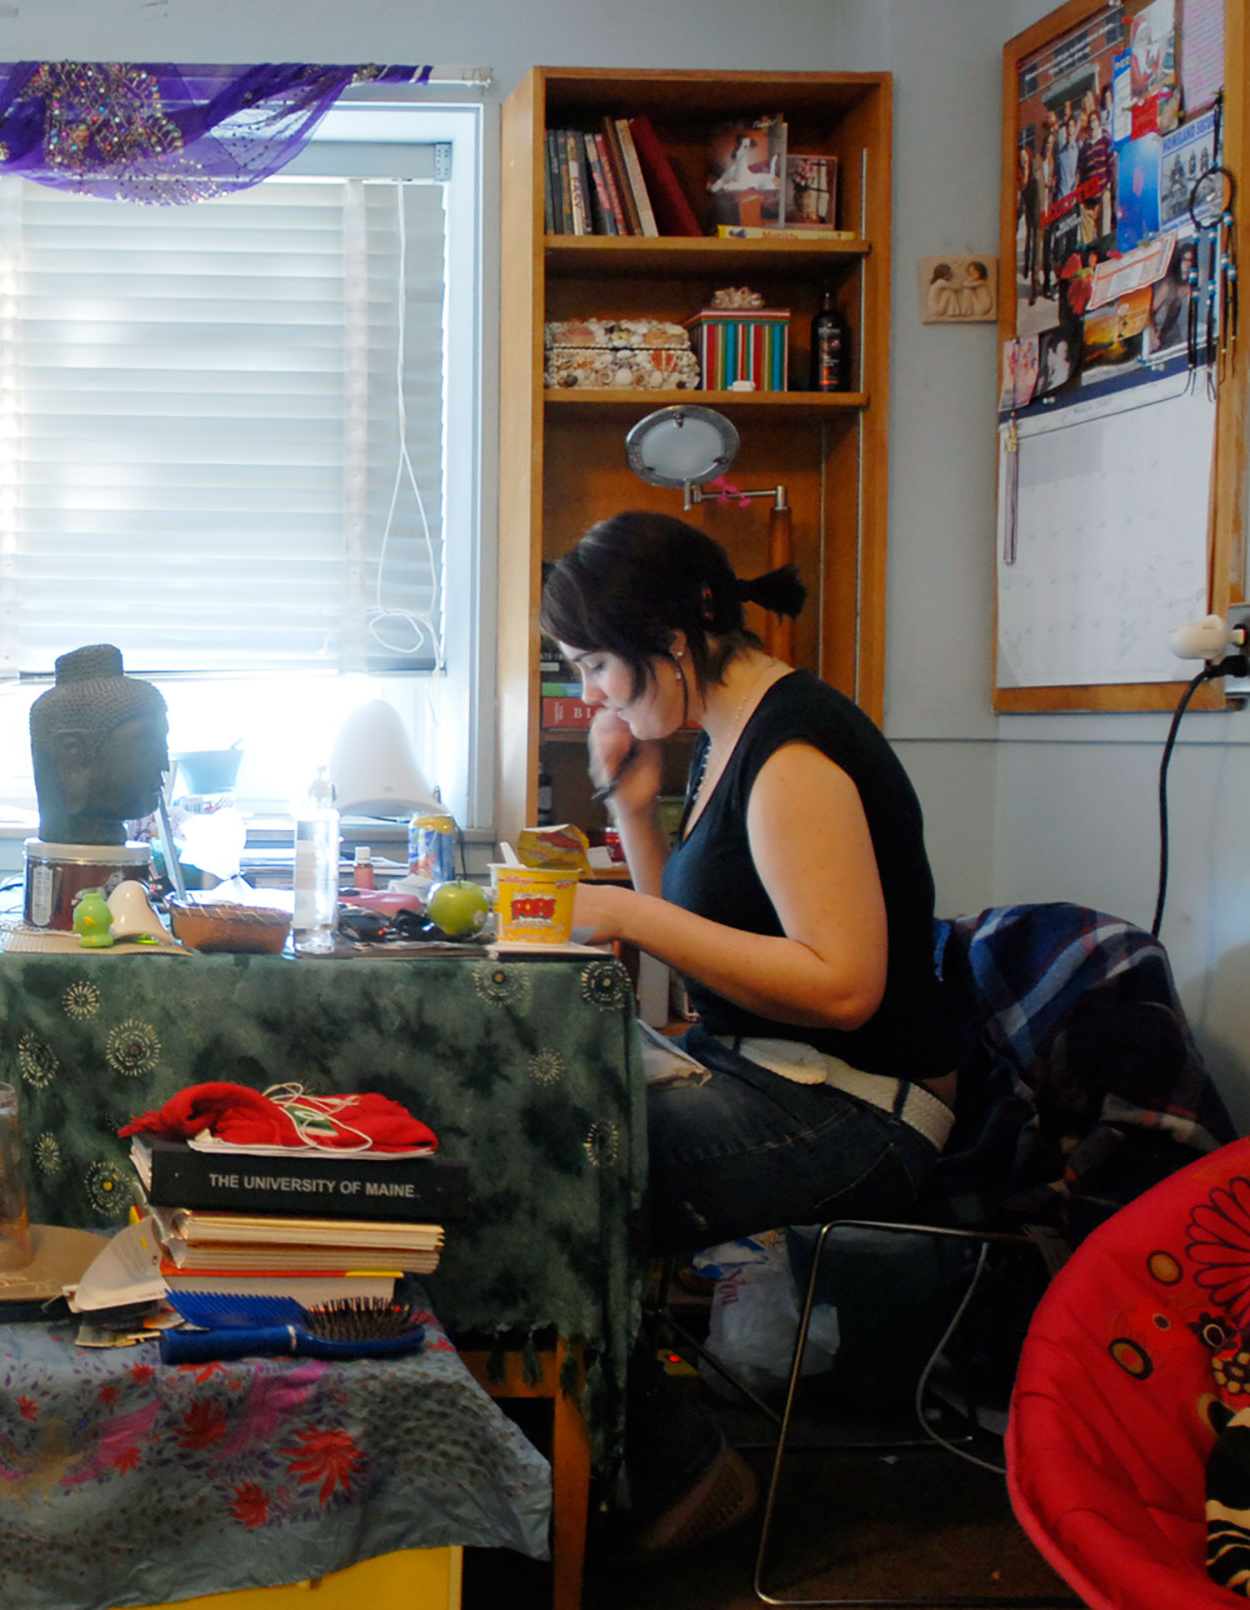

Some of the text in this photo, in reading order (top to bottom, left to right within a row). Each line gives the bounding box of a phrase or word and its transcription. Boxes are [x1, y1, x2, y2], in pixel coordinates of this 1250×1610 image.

[512, 898, 556, 920] POPS
[209, 1173, 415, 1198] THE UNIVERSITY OF MAINE
